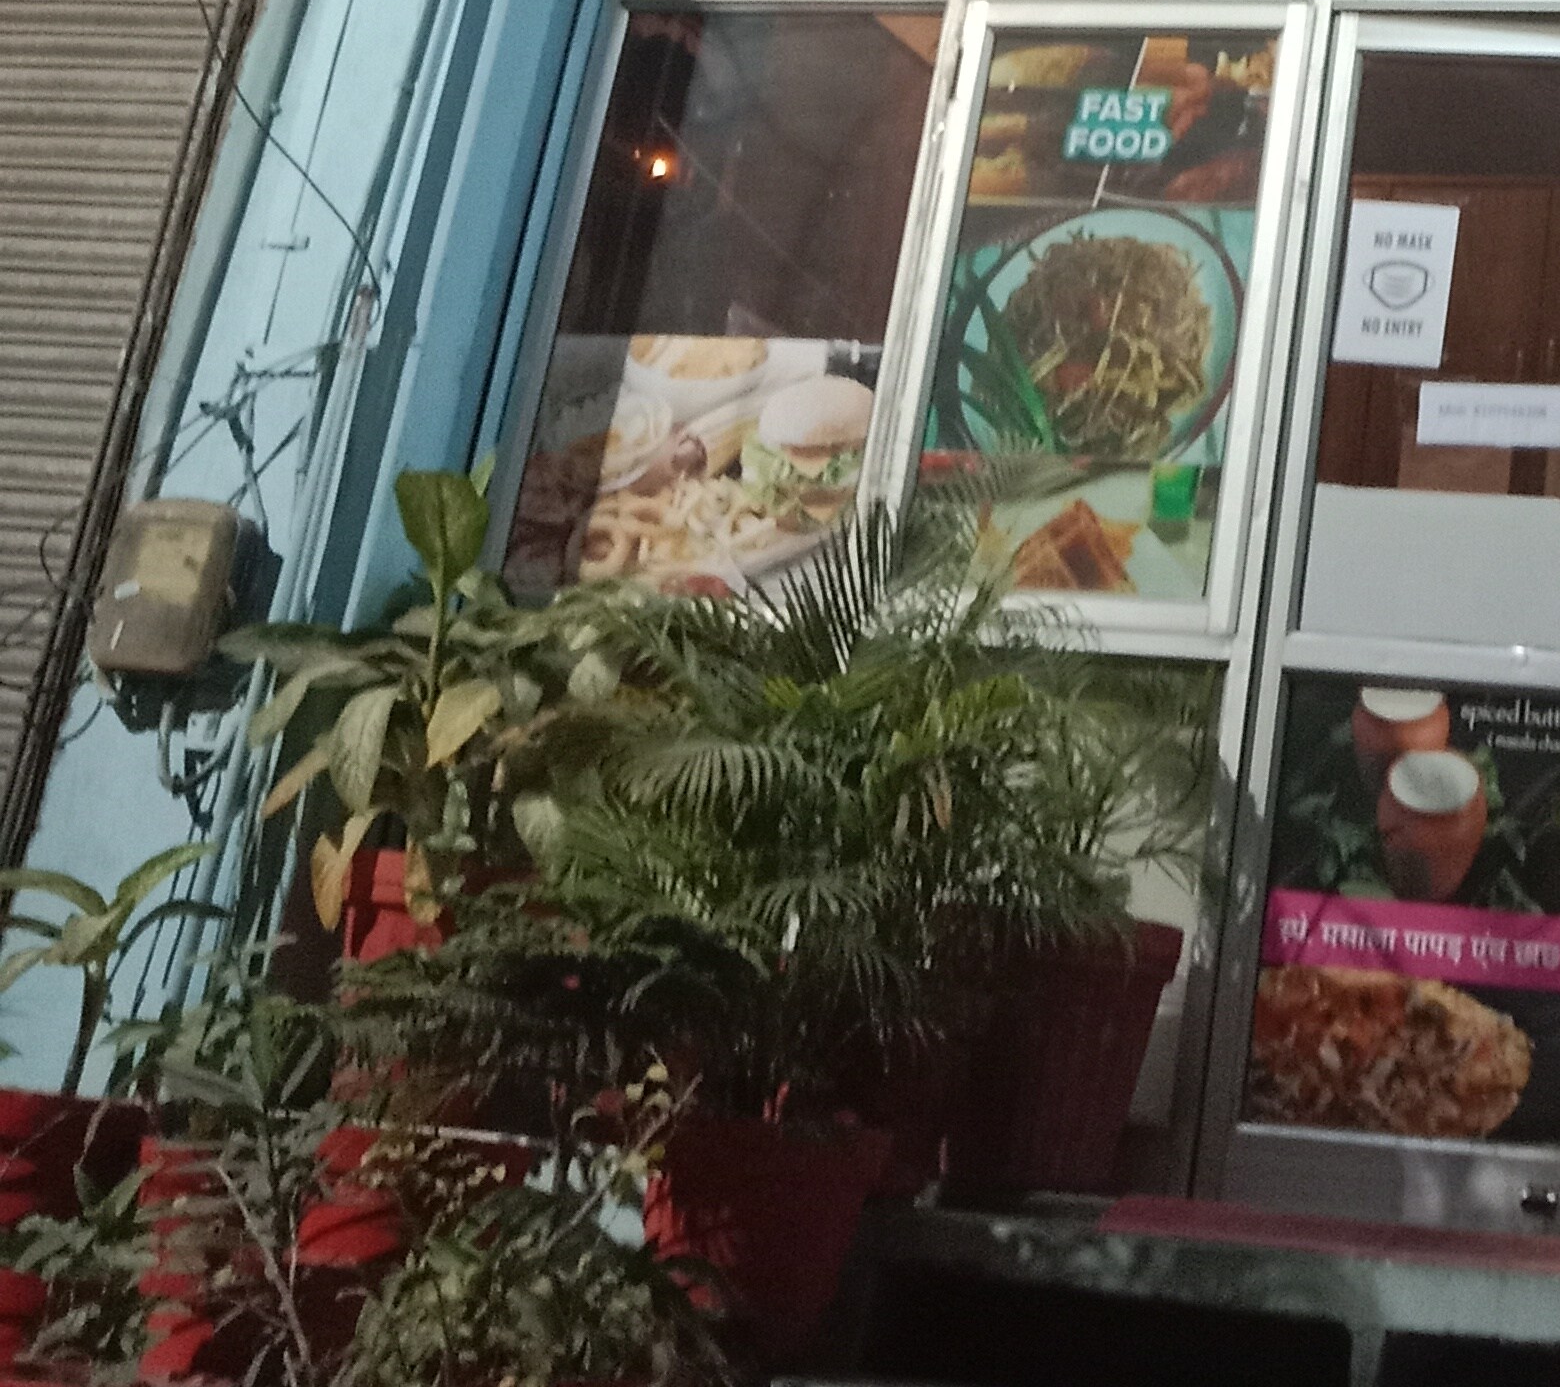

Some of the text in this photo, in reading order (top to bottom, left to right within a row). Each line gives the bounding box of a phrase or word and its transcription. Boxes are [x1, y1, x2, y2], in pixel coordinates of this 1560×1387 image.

[1080, 93, 1168, 122] FAST
[1066, 129, 1169, 158] FOOD
[1374, 231, 1433, 252] NO MASK
[1361, 318, 1423, 338] NO ENTRY
[1460, 698, 1520, 731] spiced
